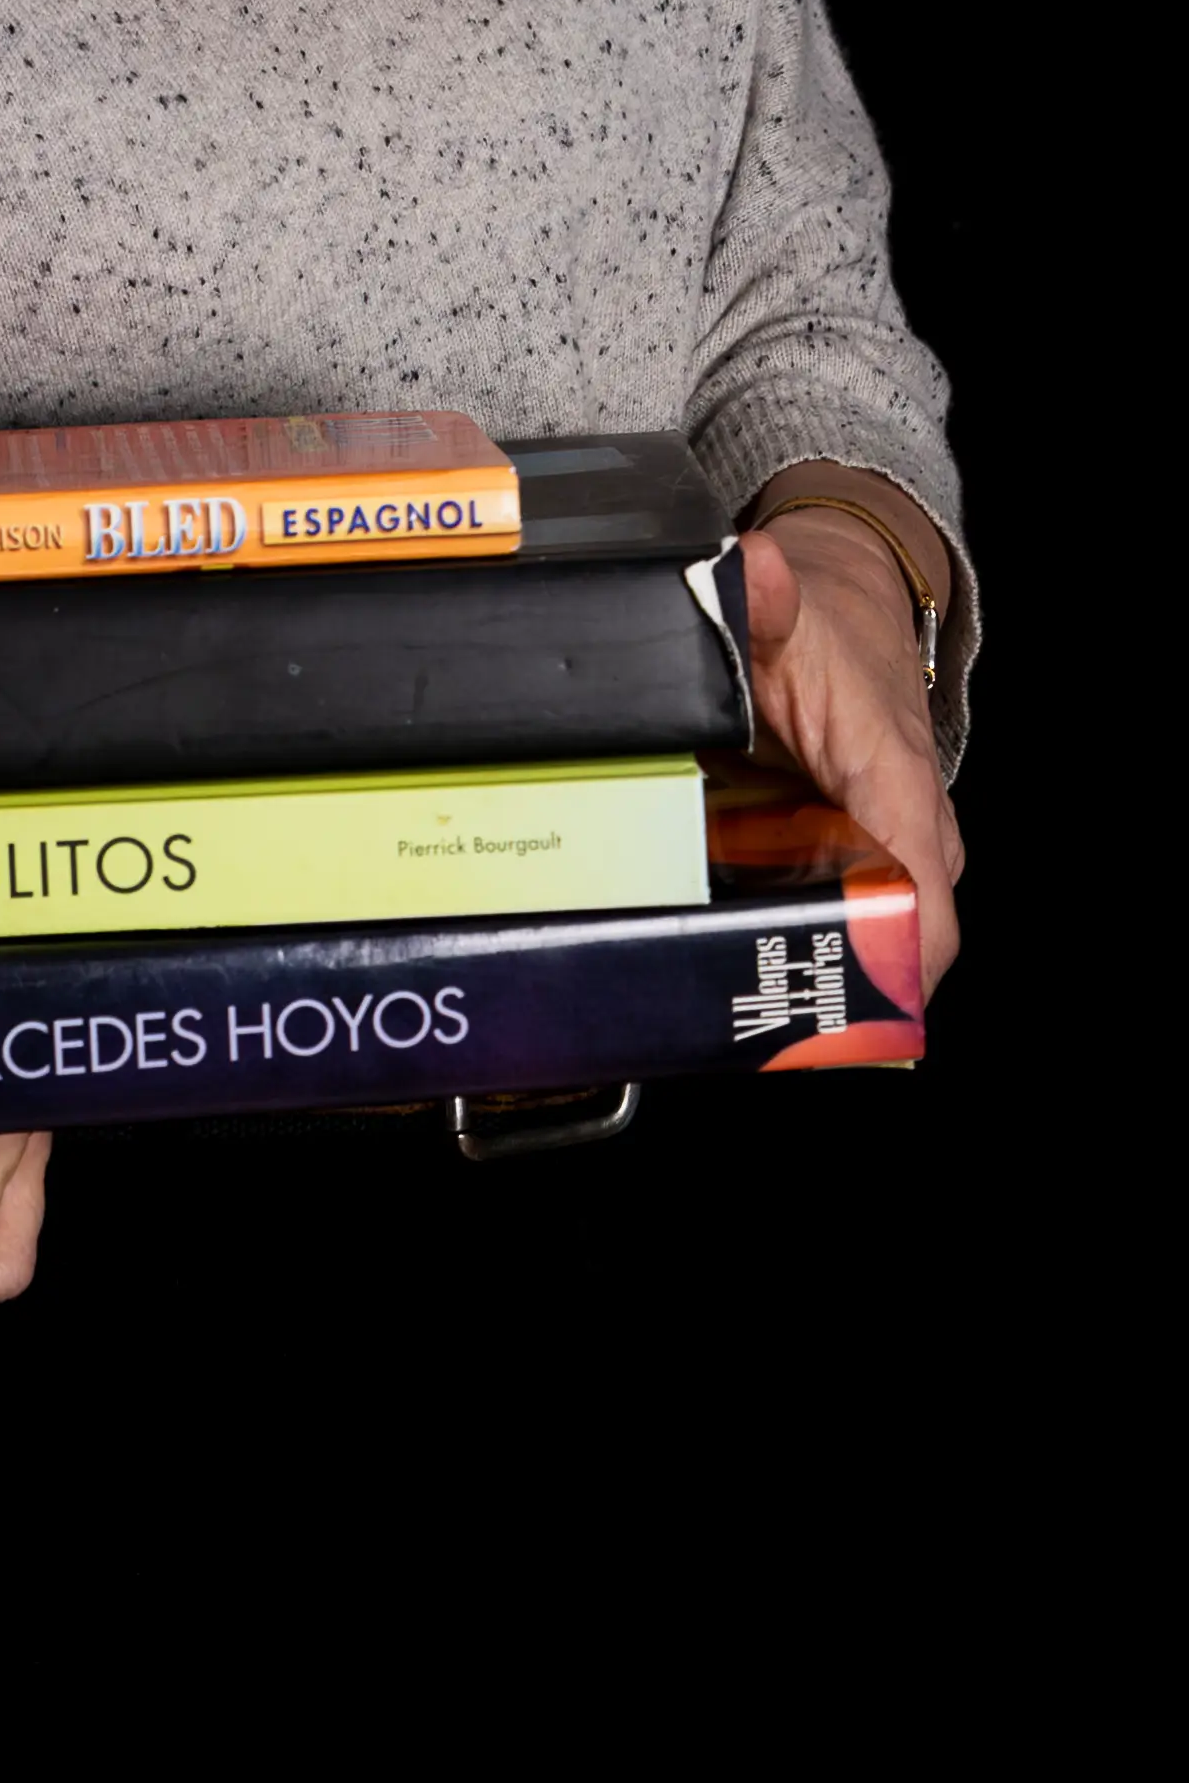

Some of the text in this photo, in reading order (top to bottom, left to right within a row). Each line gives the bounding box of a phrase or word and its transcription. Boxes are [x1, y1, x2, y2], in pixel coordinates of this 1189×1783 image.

[83, 496, 247, 561] BLED
[282, 500, 483, 537] ESPAGNOL
[397, 831, 562, 858] Pierrick Bourgault
[732, 935, 811, 1042] Villegas
[795, 931, 847, 1034] editores
[228, 987, 469, 1061] HOYOS
